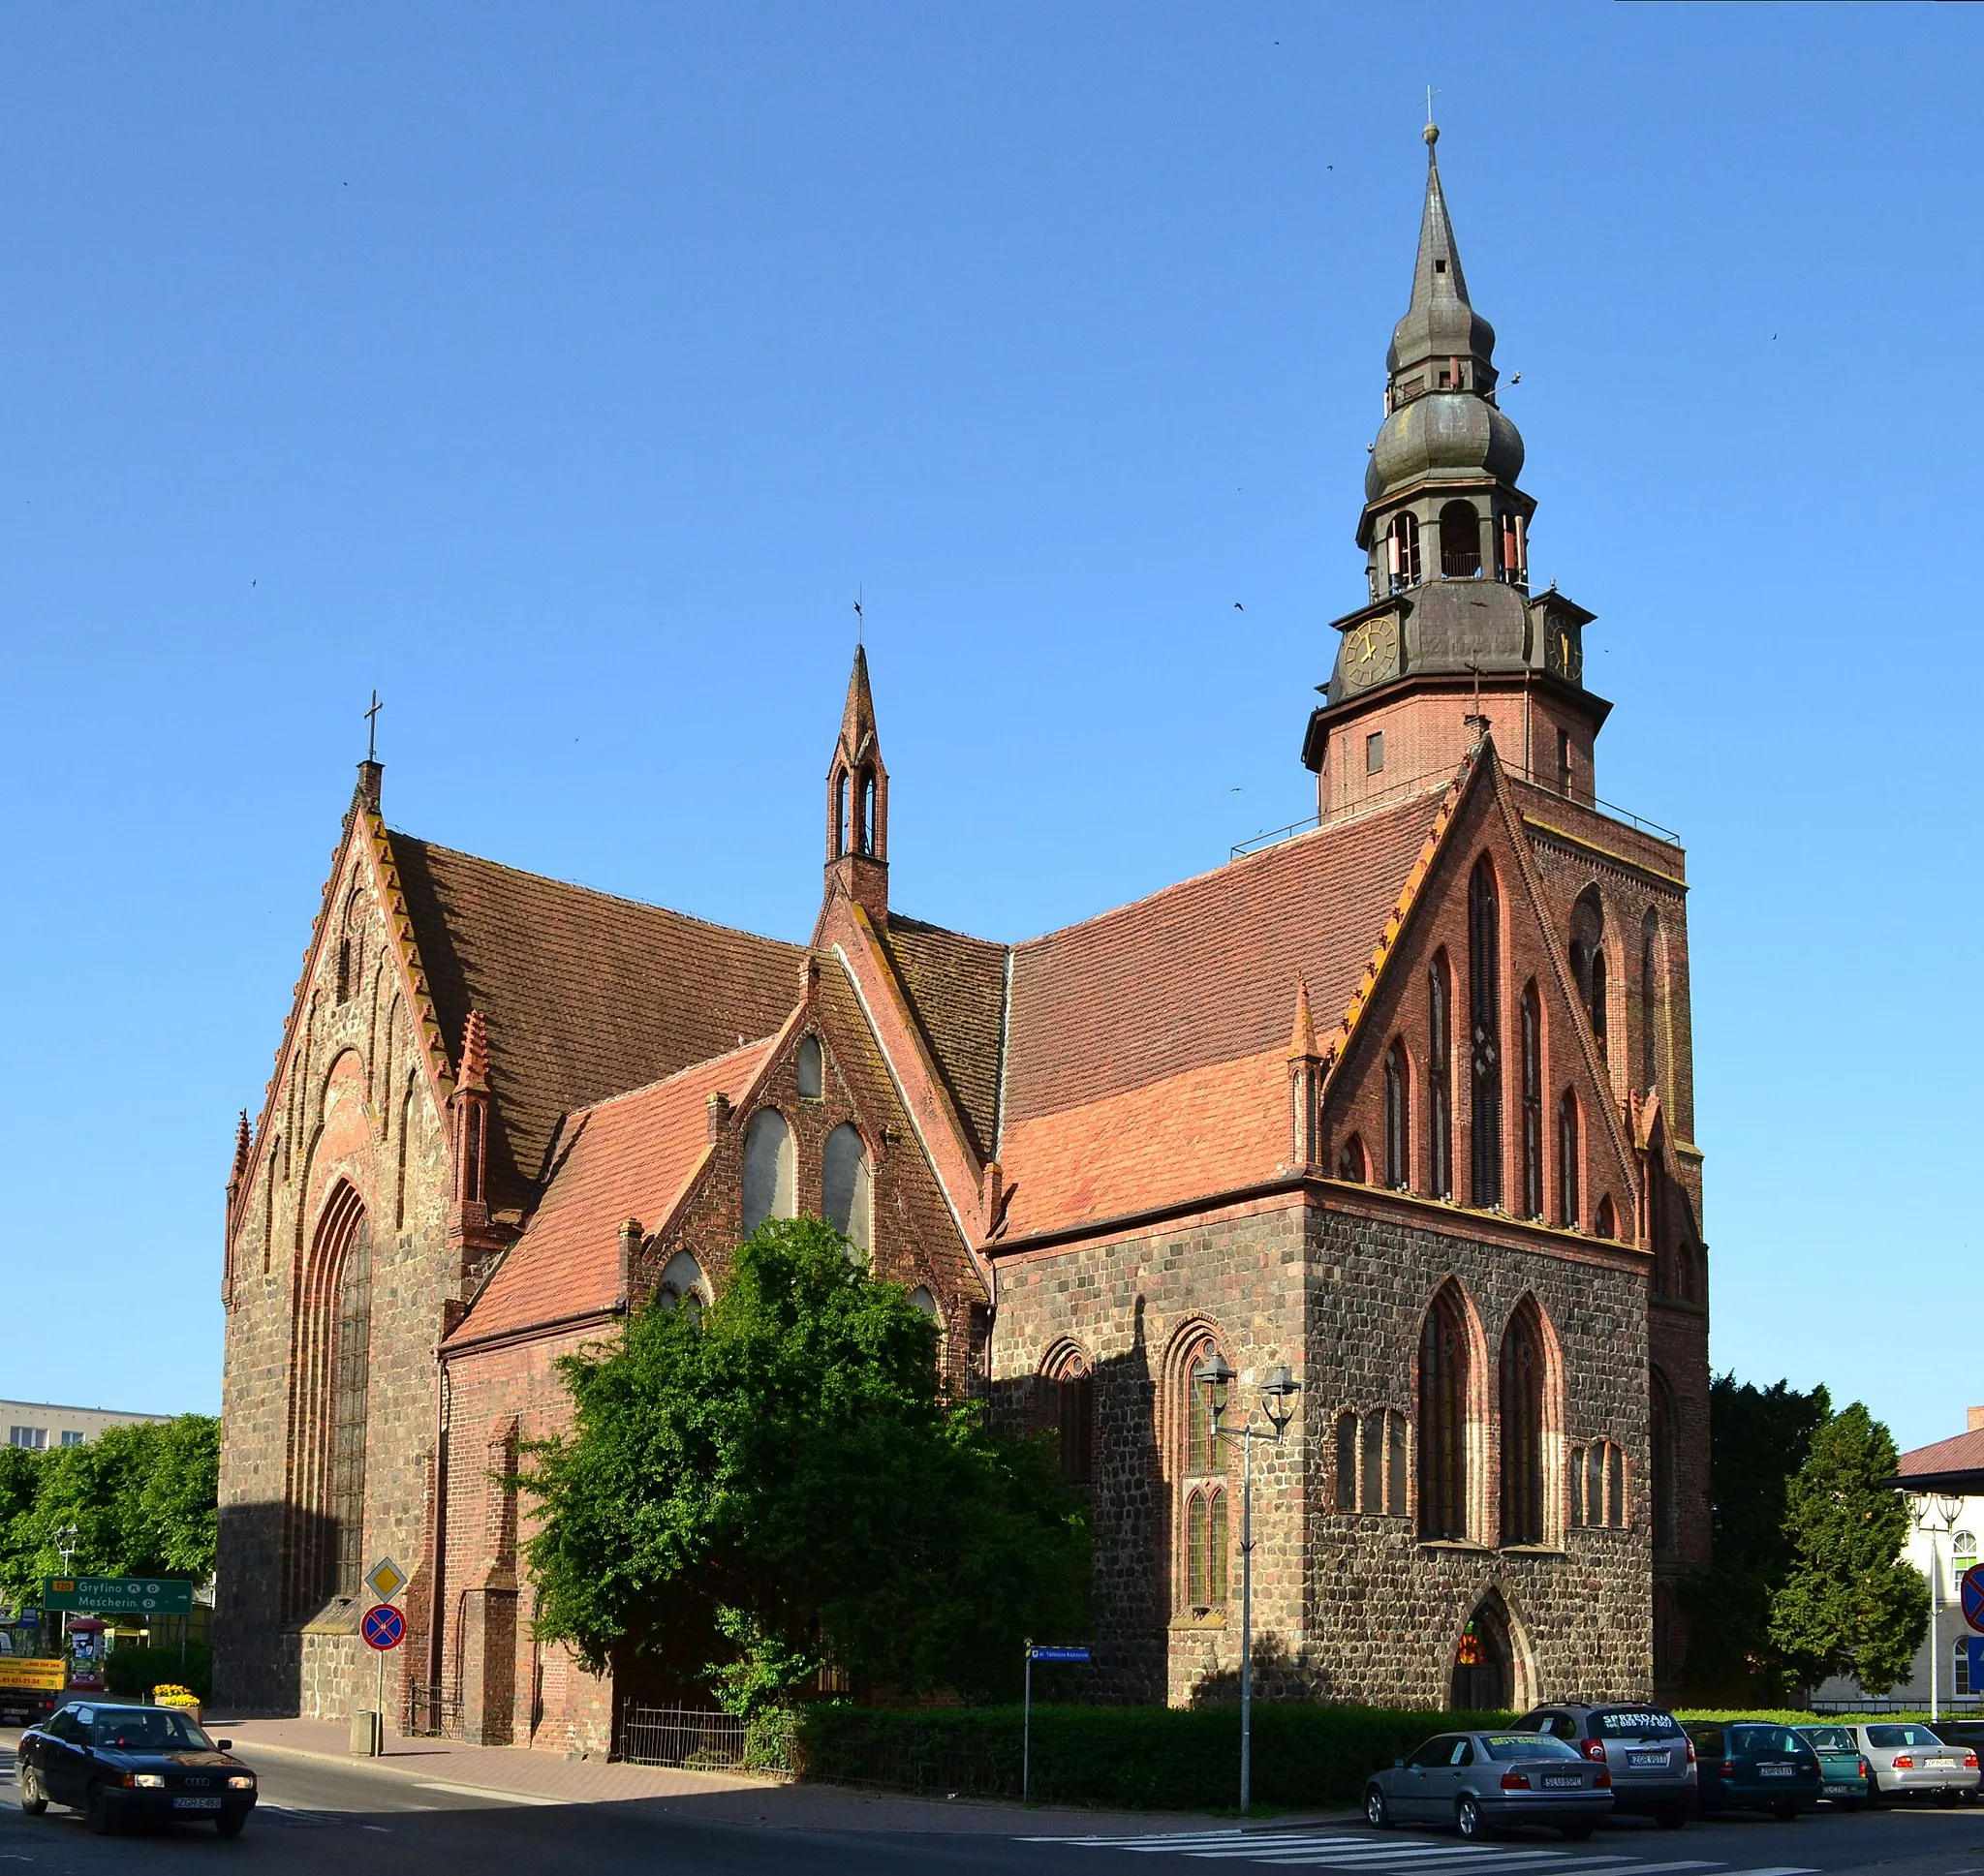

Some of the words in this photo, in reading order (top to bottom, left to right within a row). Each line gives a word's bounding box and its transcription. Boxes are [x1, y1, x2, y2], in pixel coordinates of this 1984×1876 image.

[56, 1582, 71, 1590] 120
[78, 1582, 122, 1594] Gryfino
[78, 1597, 136, 1608] Mescherin
[1603, 1713, 1671, 1723] SPRZEDAM
[178, 1798, 198, 1808] ZGR
